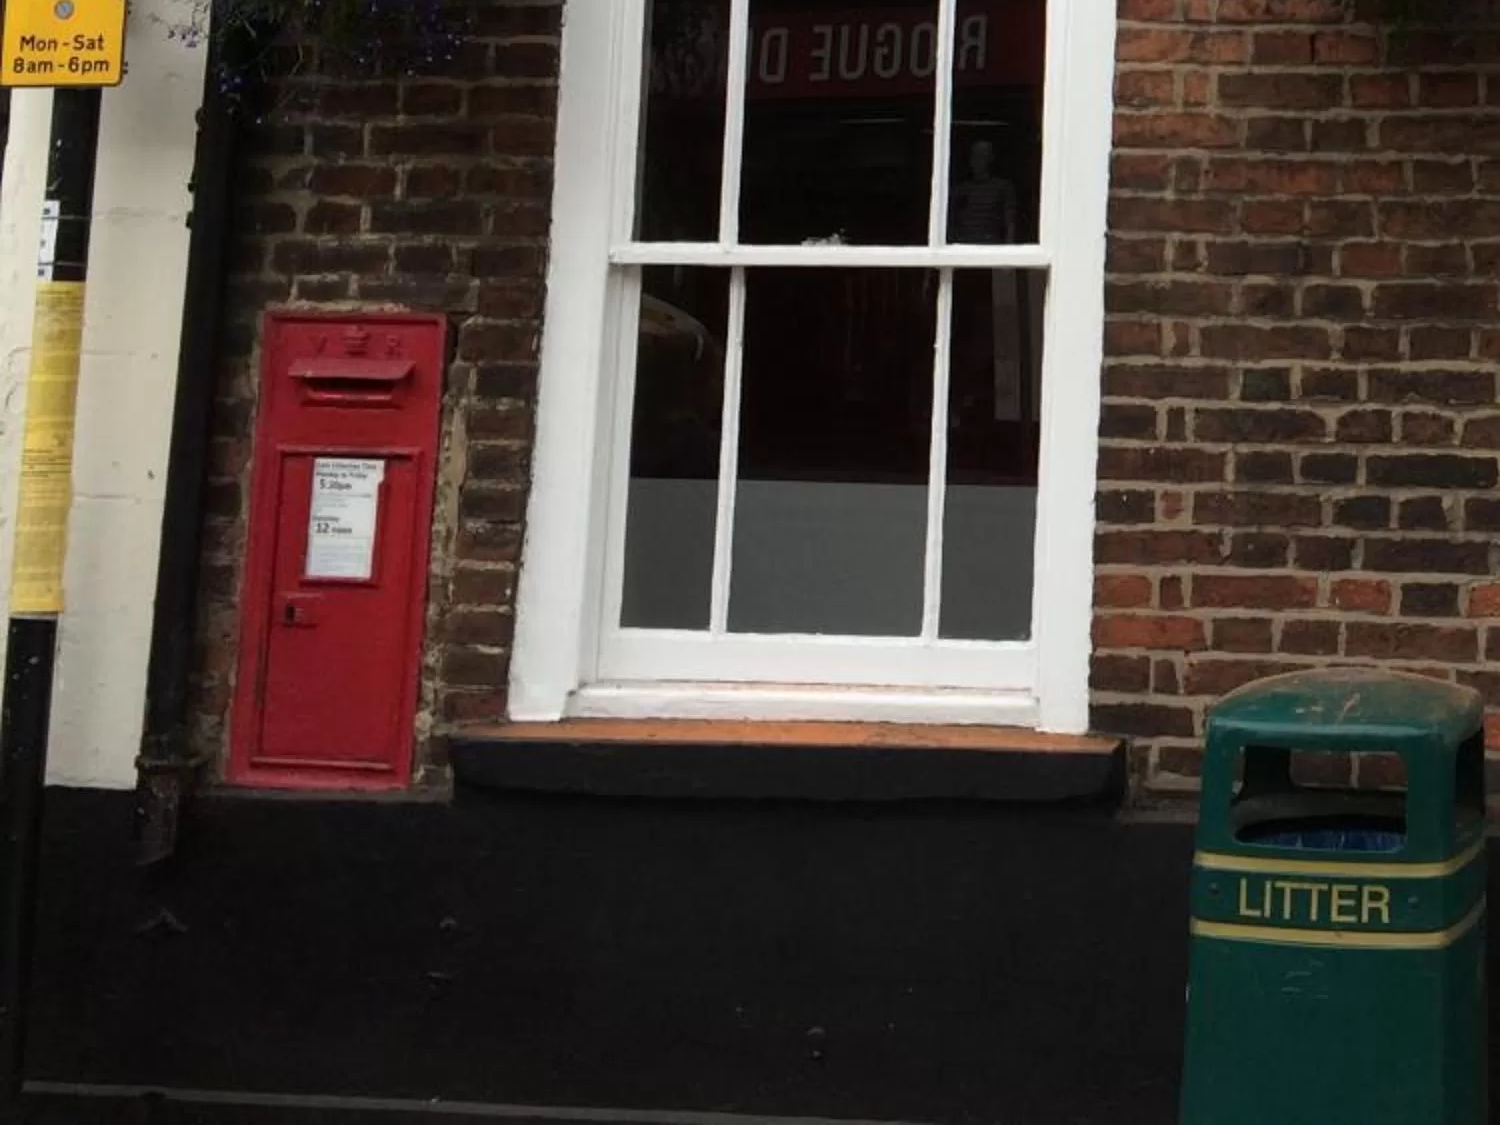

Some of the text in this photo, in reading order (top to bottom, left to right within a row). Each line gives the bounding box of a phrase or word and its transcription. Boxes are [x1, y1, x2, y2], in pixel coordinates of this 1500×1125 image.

[20, 34, 58, 52] Mon
[72, 32, 105, 51] Sat
[68, 56, 110, 75] 6pm
[1238, 877, 1391, 924] LITTER
